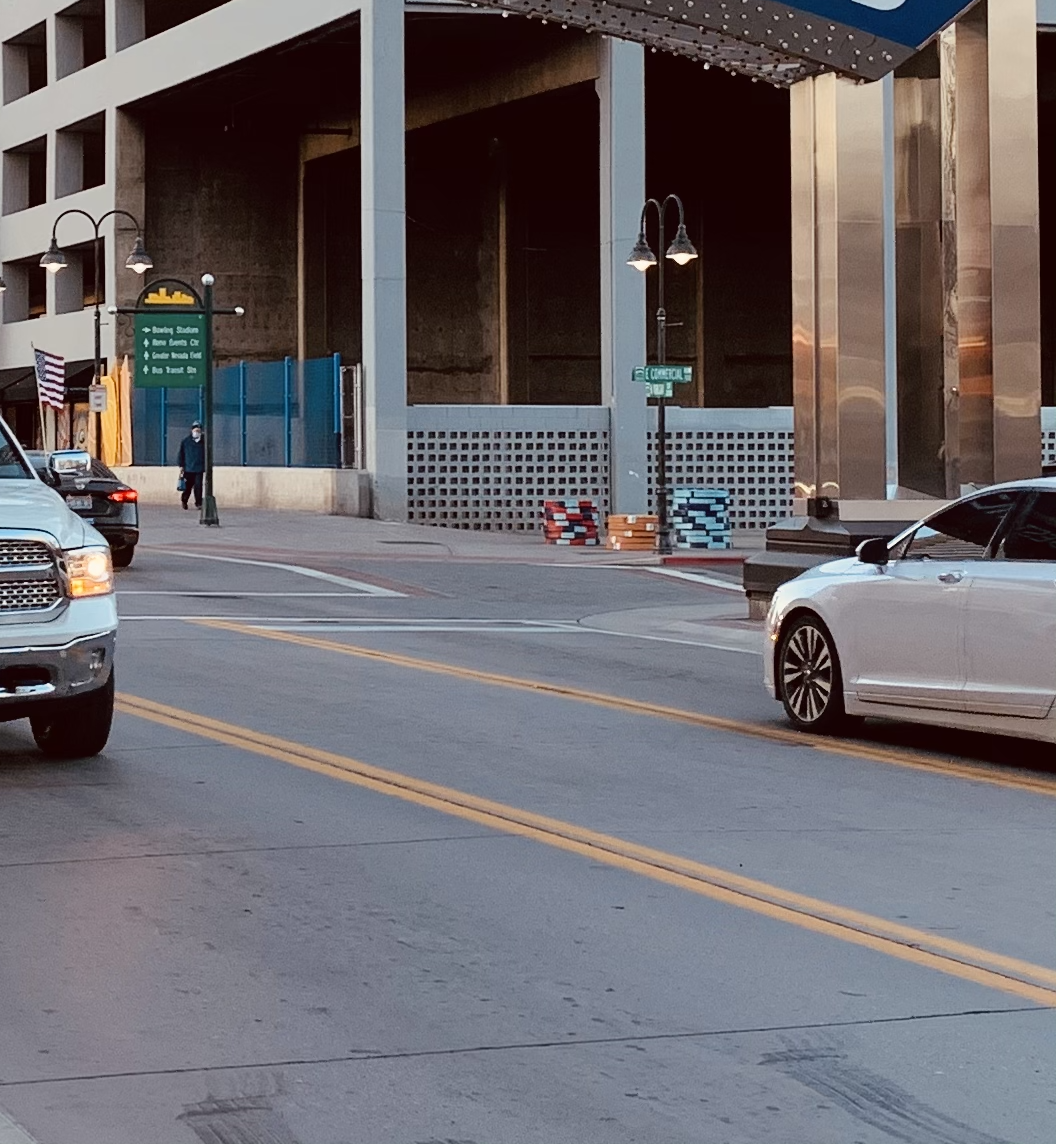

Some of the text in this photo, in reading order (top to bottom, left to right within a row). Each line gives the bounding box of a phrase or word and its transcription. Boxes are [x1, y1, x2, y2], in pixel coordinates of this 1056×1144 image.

[152, 326, 199, 335] Bowling Stadium
[169, 338, 187, 346] Events
[165, 366, 184, 374] Transit
